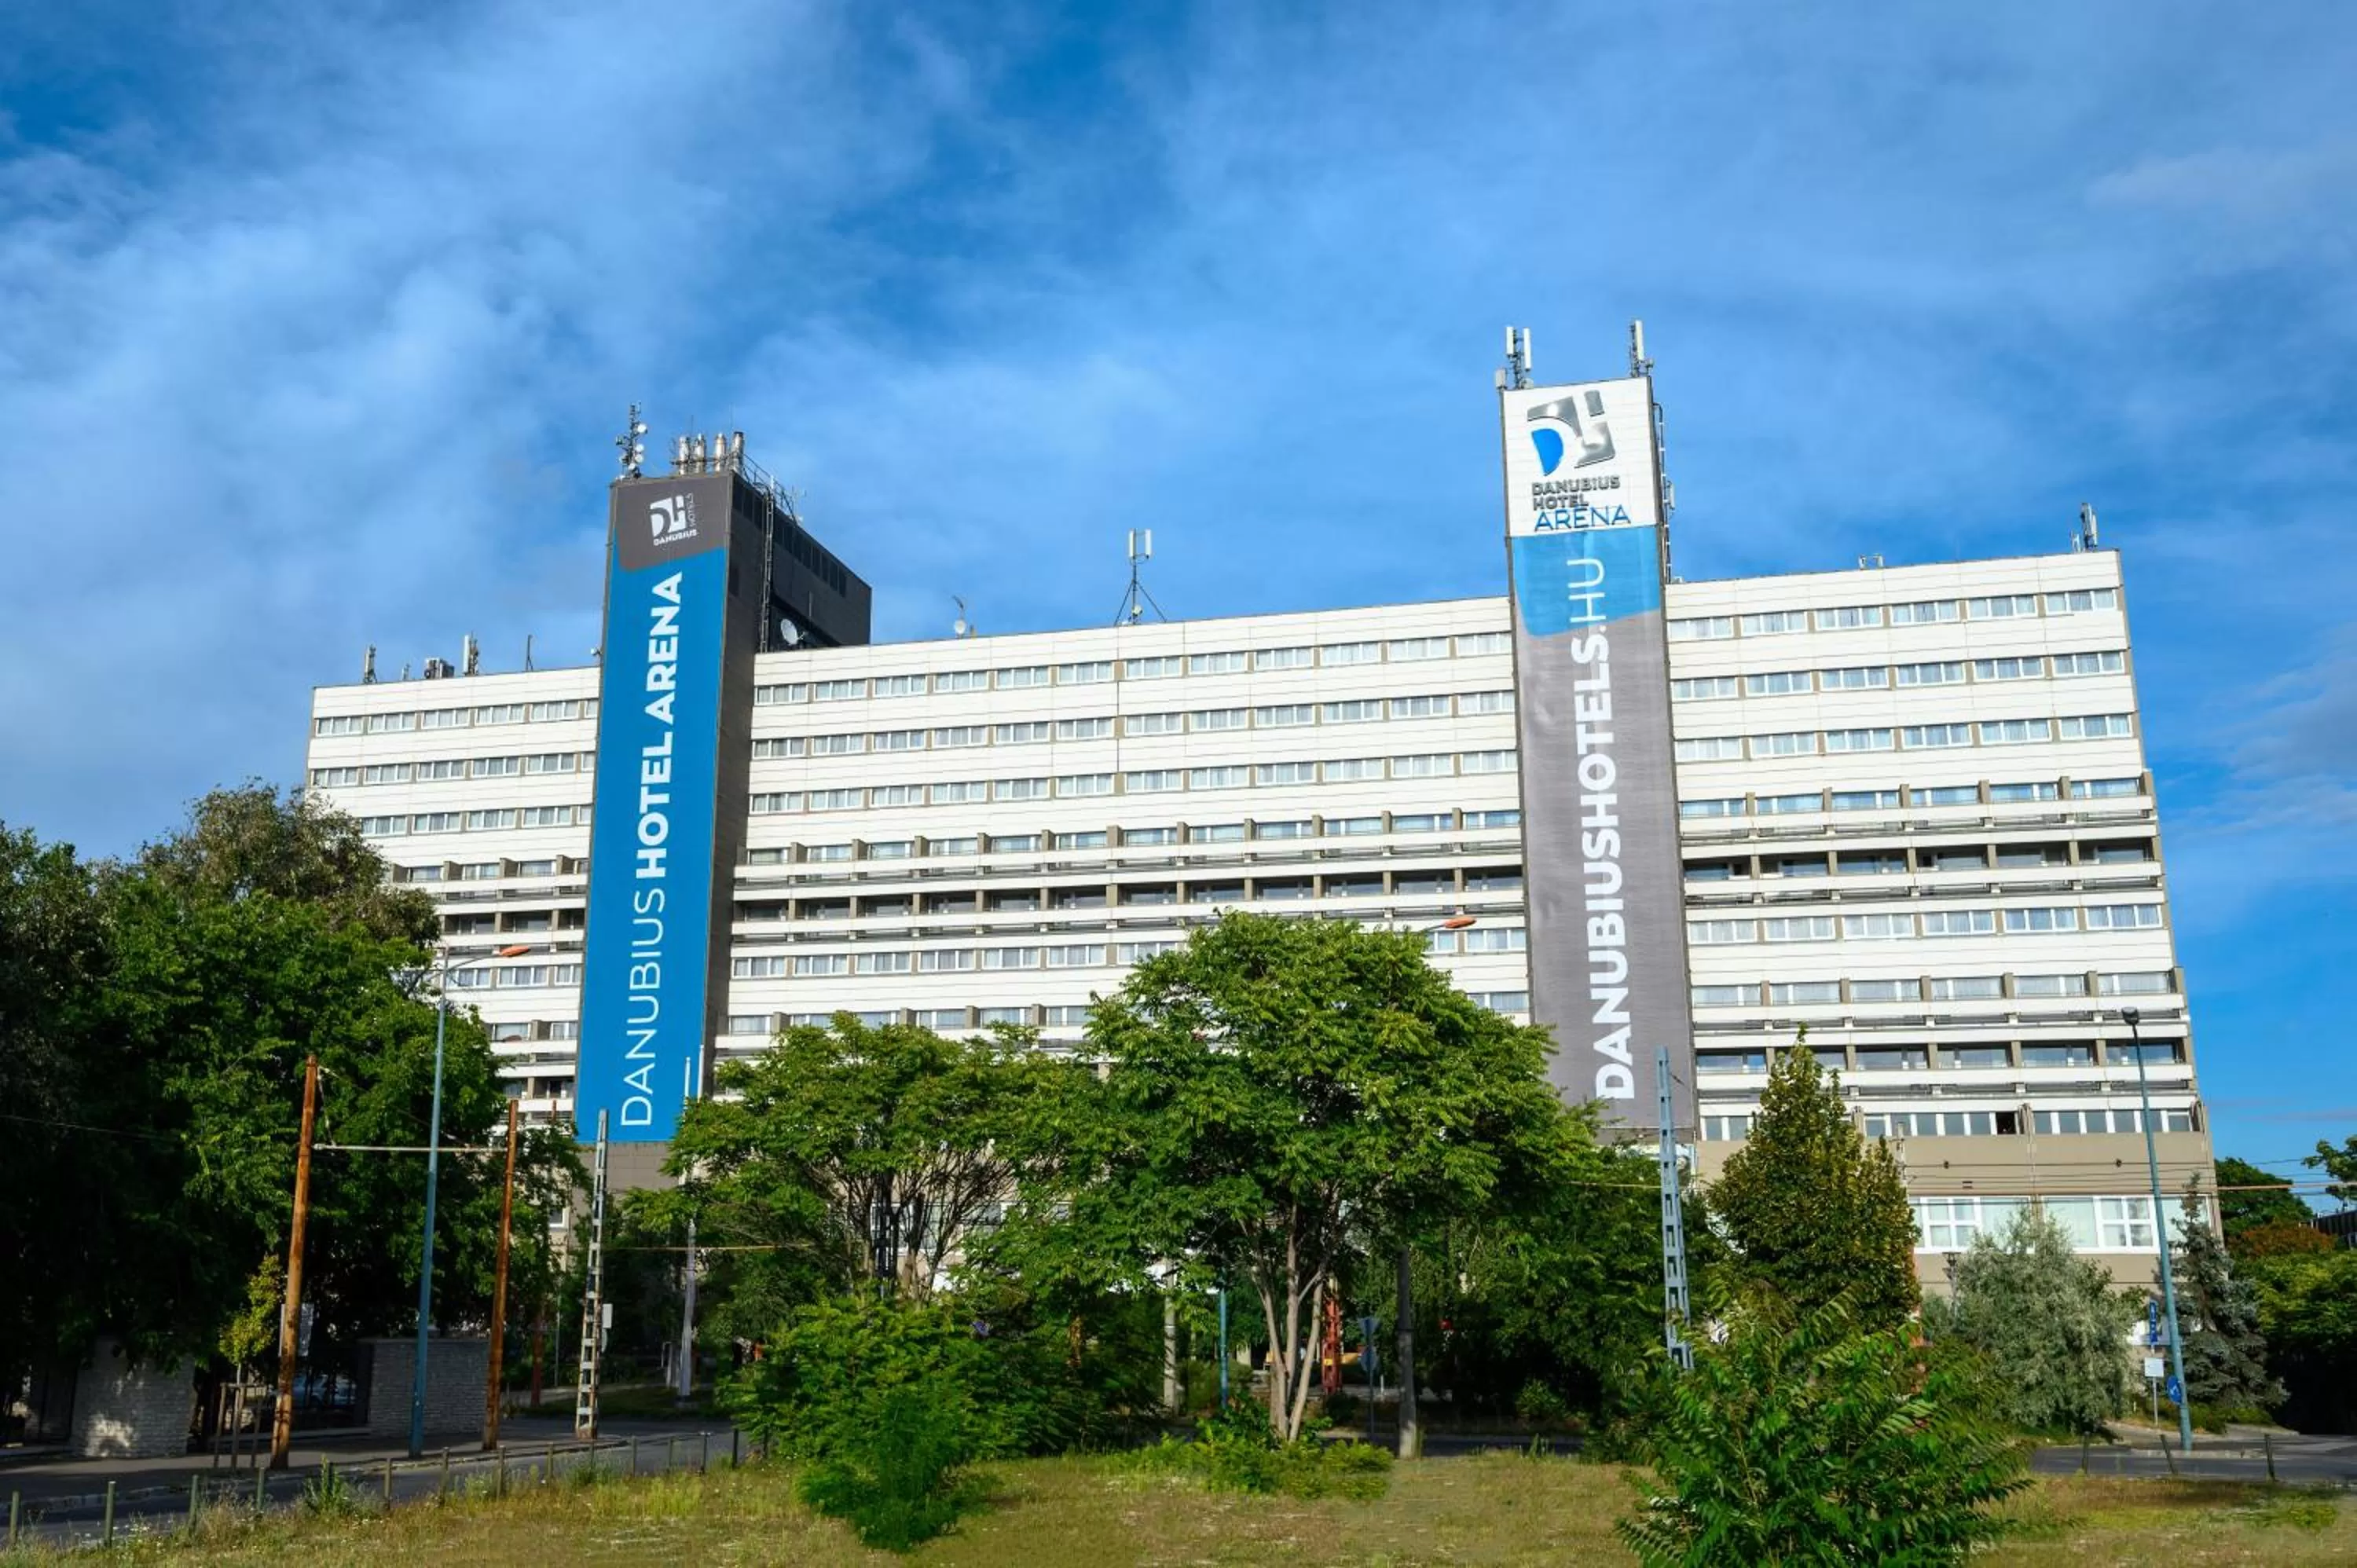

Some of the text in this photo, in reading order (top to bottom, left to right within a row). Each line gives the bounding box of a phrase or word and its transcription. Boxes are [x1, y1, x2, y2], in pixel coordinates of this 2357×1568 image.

[1532, 474, 1621, 496] DANUBIUS
[1533, 493, 1589, 511] HOTEL
[1534, 504, 1631, 532] ARENA
[653, 529, 697, 546] DANUBIUS
[621, 571, 684, 1126] DANUBIUS HOTEL ARENA
